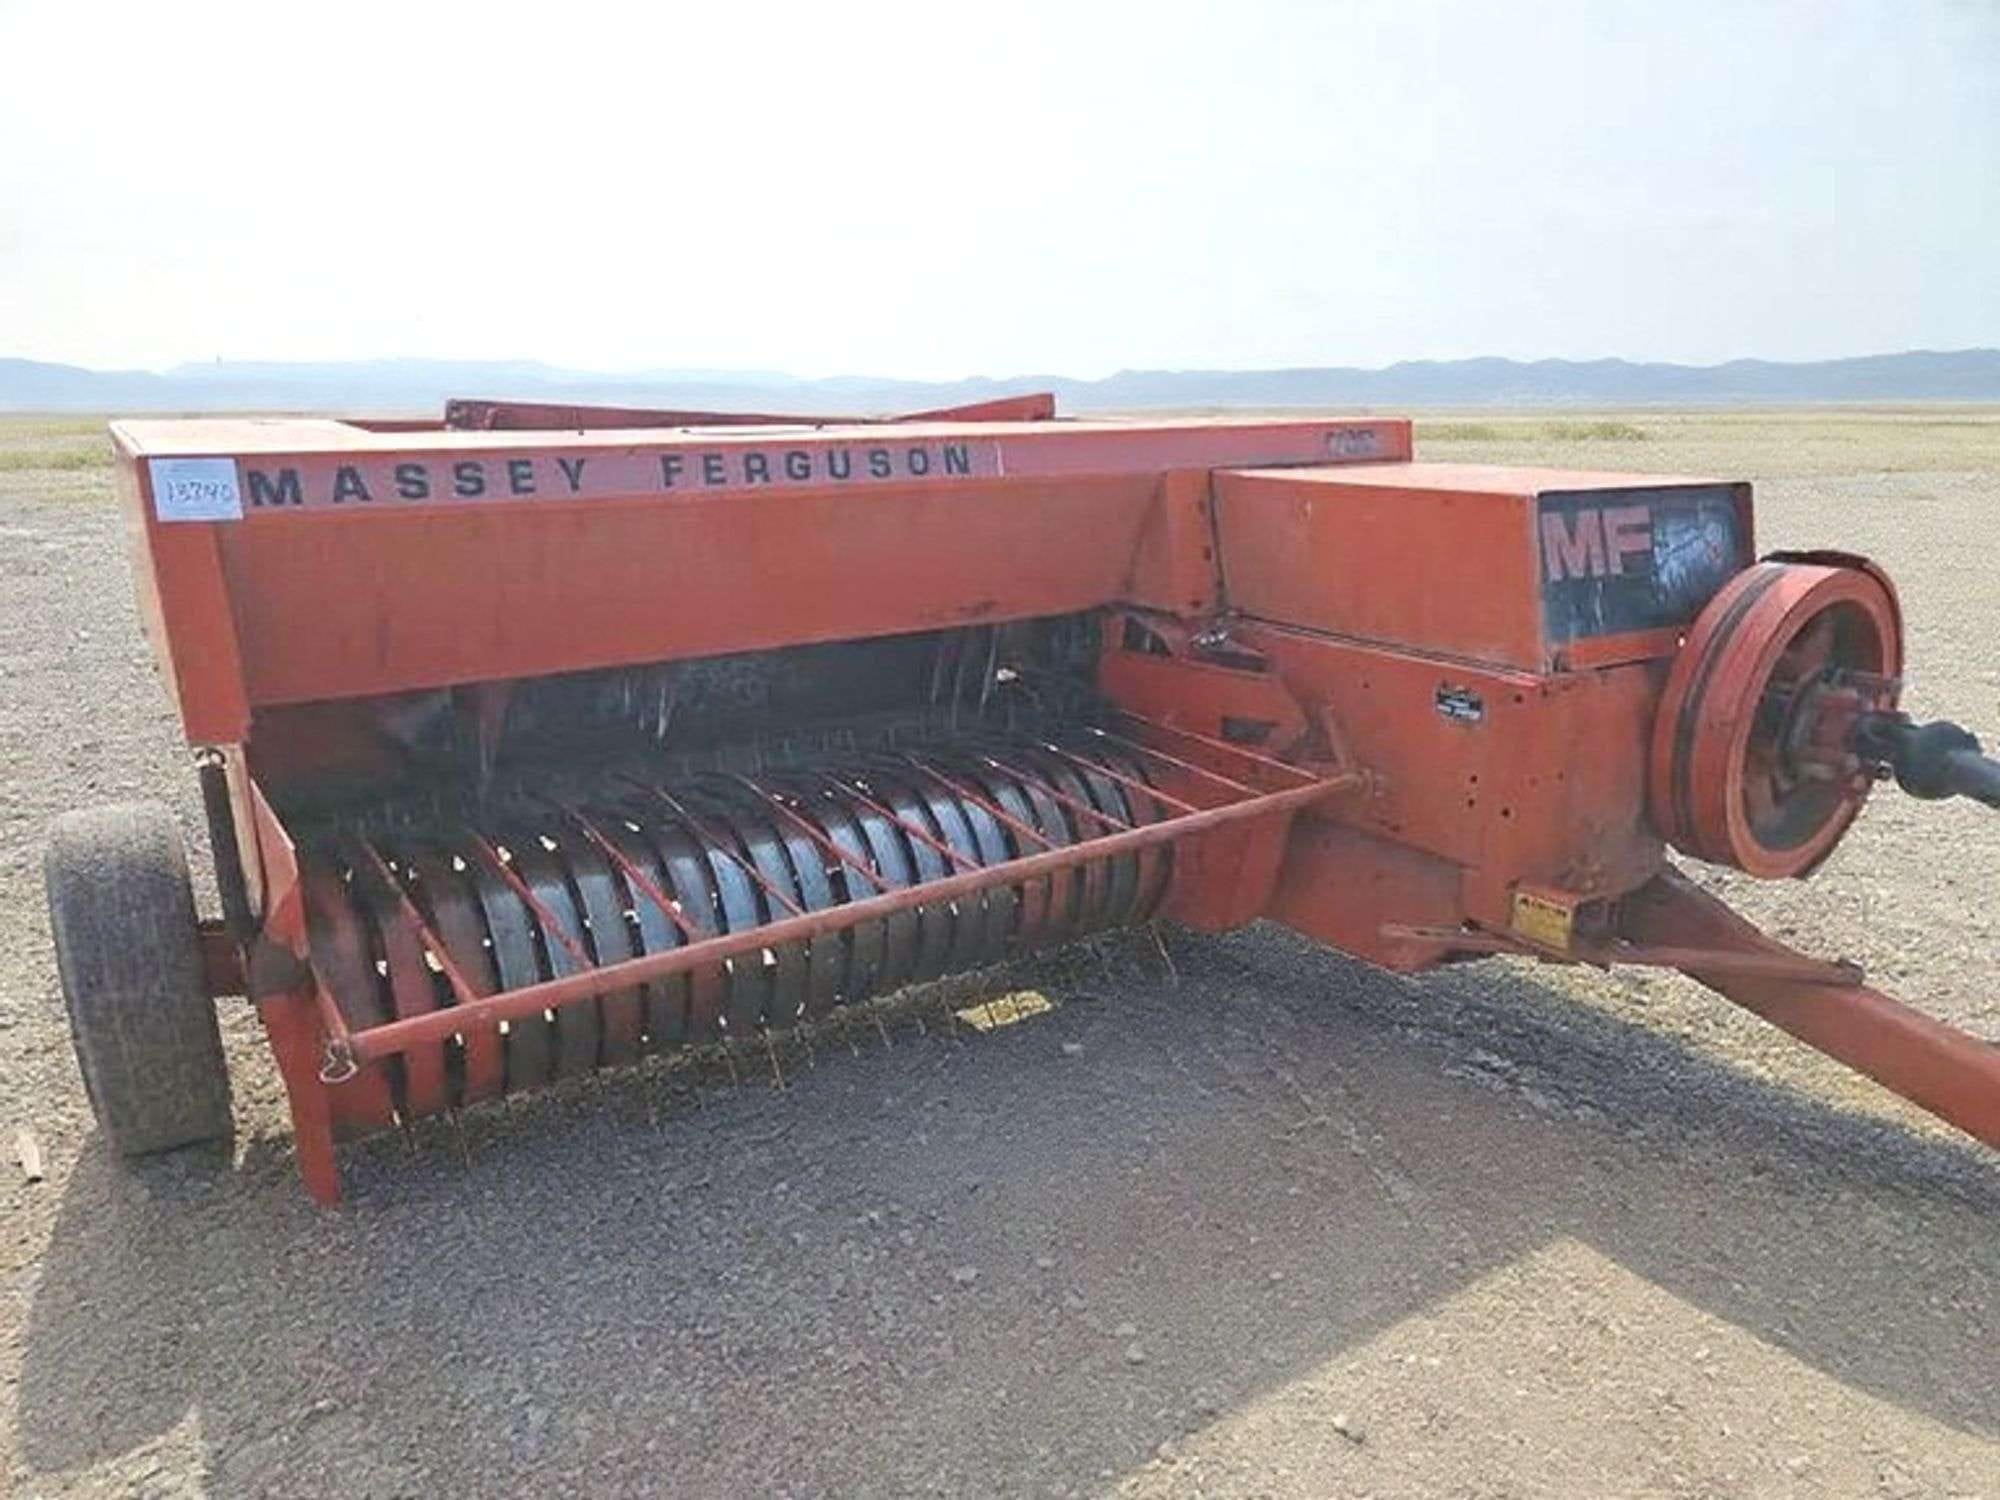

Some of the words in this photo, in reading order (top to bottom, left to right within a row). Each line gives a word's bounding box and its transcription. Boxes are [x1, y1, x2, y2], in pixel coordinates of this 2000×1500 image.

[247, 456, 586, 507] MASSEY
[661, 446, 972, 488] FERGUSON
[1540, 505, 1651, 583] MF
